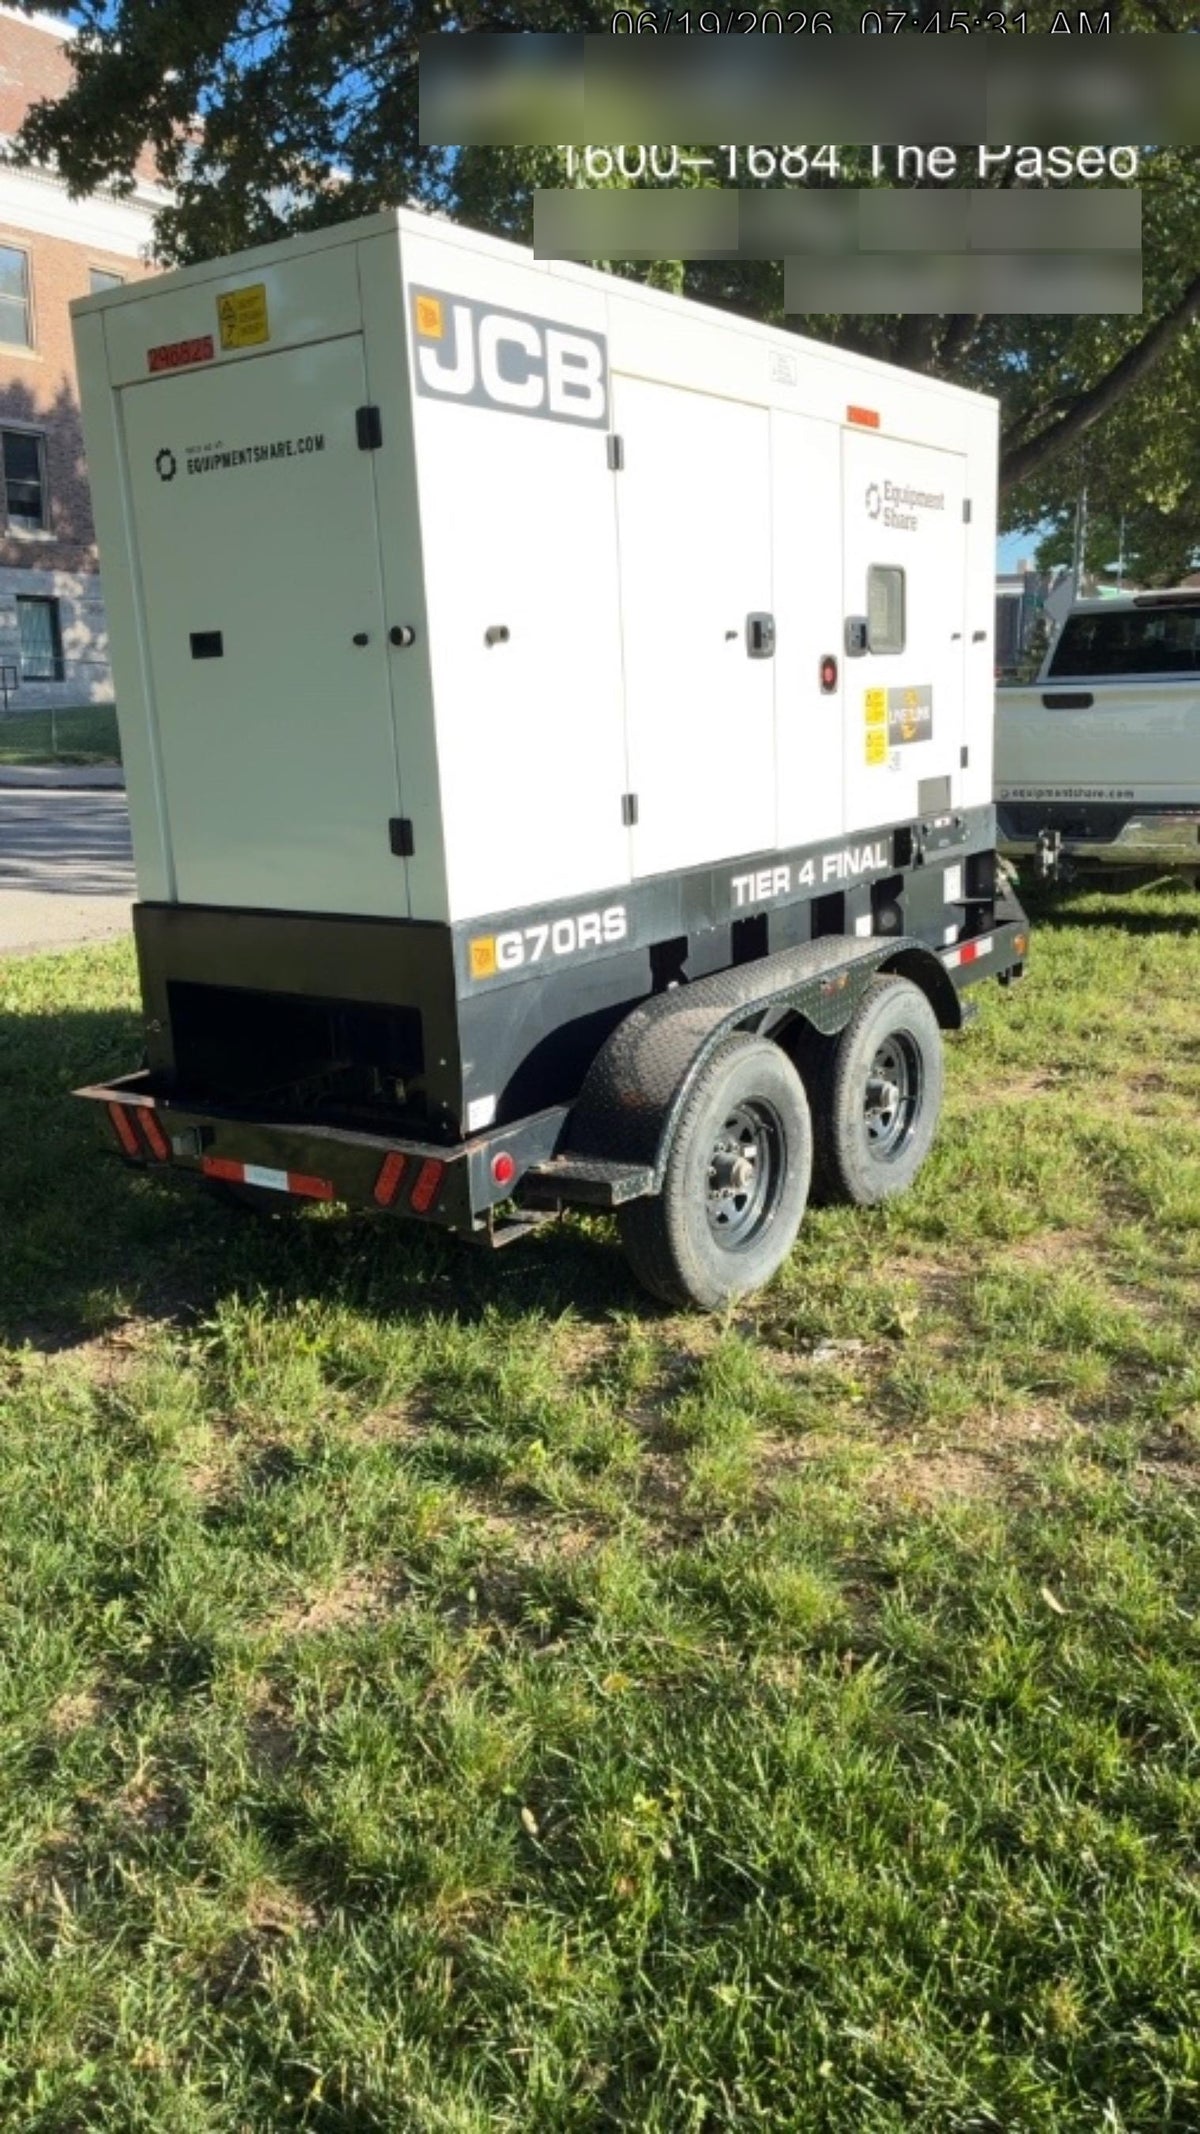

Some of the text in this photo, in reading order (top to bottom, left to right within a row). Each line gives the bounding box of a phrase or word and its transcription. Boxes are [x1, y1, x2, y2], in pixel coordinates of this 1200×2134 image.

[419, 305, 606, 420] JCB
[186, 434, 326, 475] EQUIPMENTSHARE.COM
[883, 479, 945, 511] Equipment
[883, 507, 918, 531] Share
[732, 843, 888, 906] TIER 4 FINAL
[495, 906, 628, 970] G70RS
